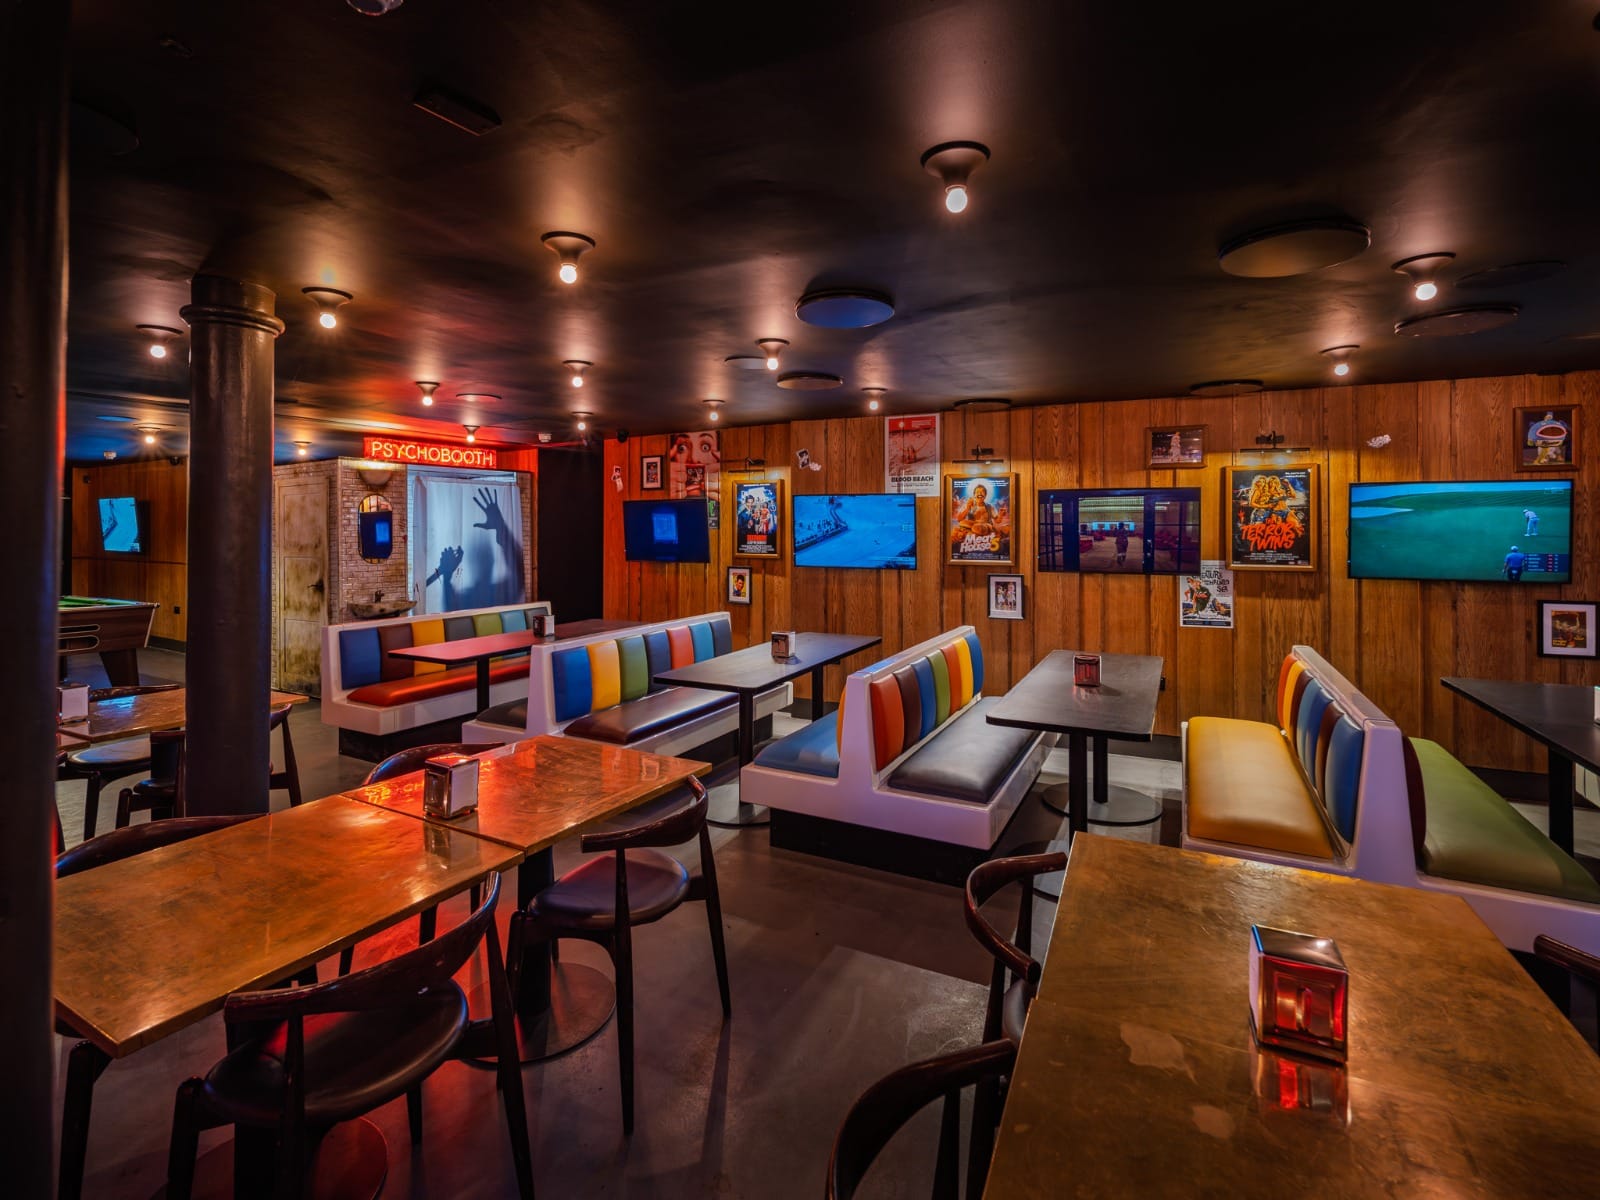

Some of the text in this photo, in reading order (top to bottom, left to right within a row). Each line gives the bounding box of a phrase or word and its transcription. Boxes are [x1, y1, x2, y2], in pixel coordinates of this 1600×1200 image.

[371, 441, 494, 466] PSYCHOBOOTH
[1241, 522, 1295, 540] TERROR
[990, 537, 1000, 552] 5
[1249, 536, 1295, 552] TWINS
